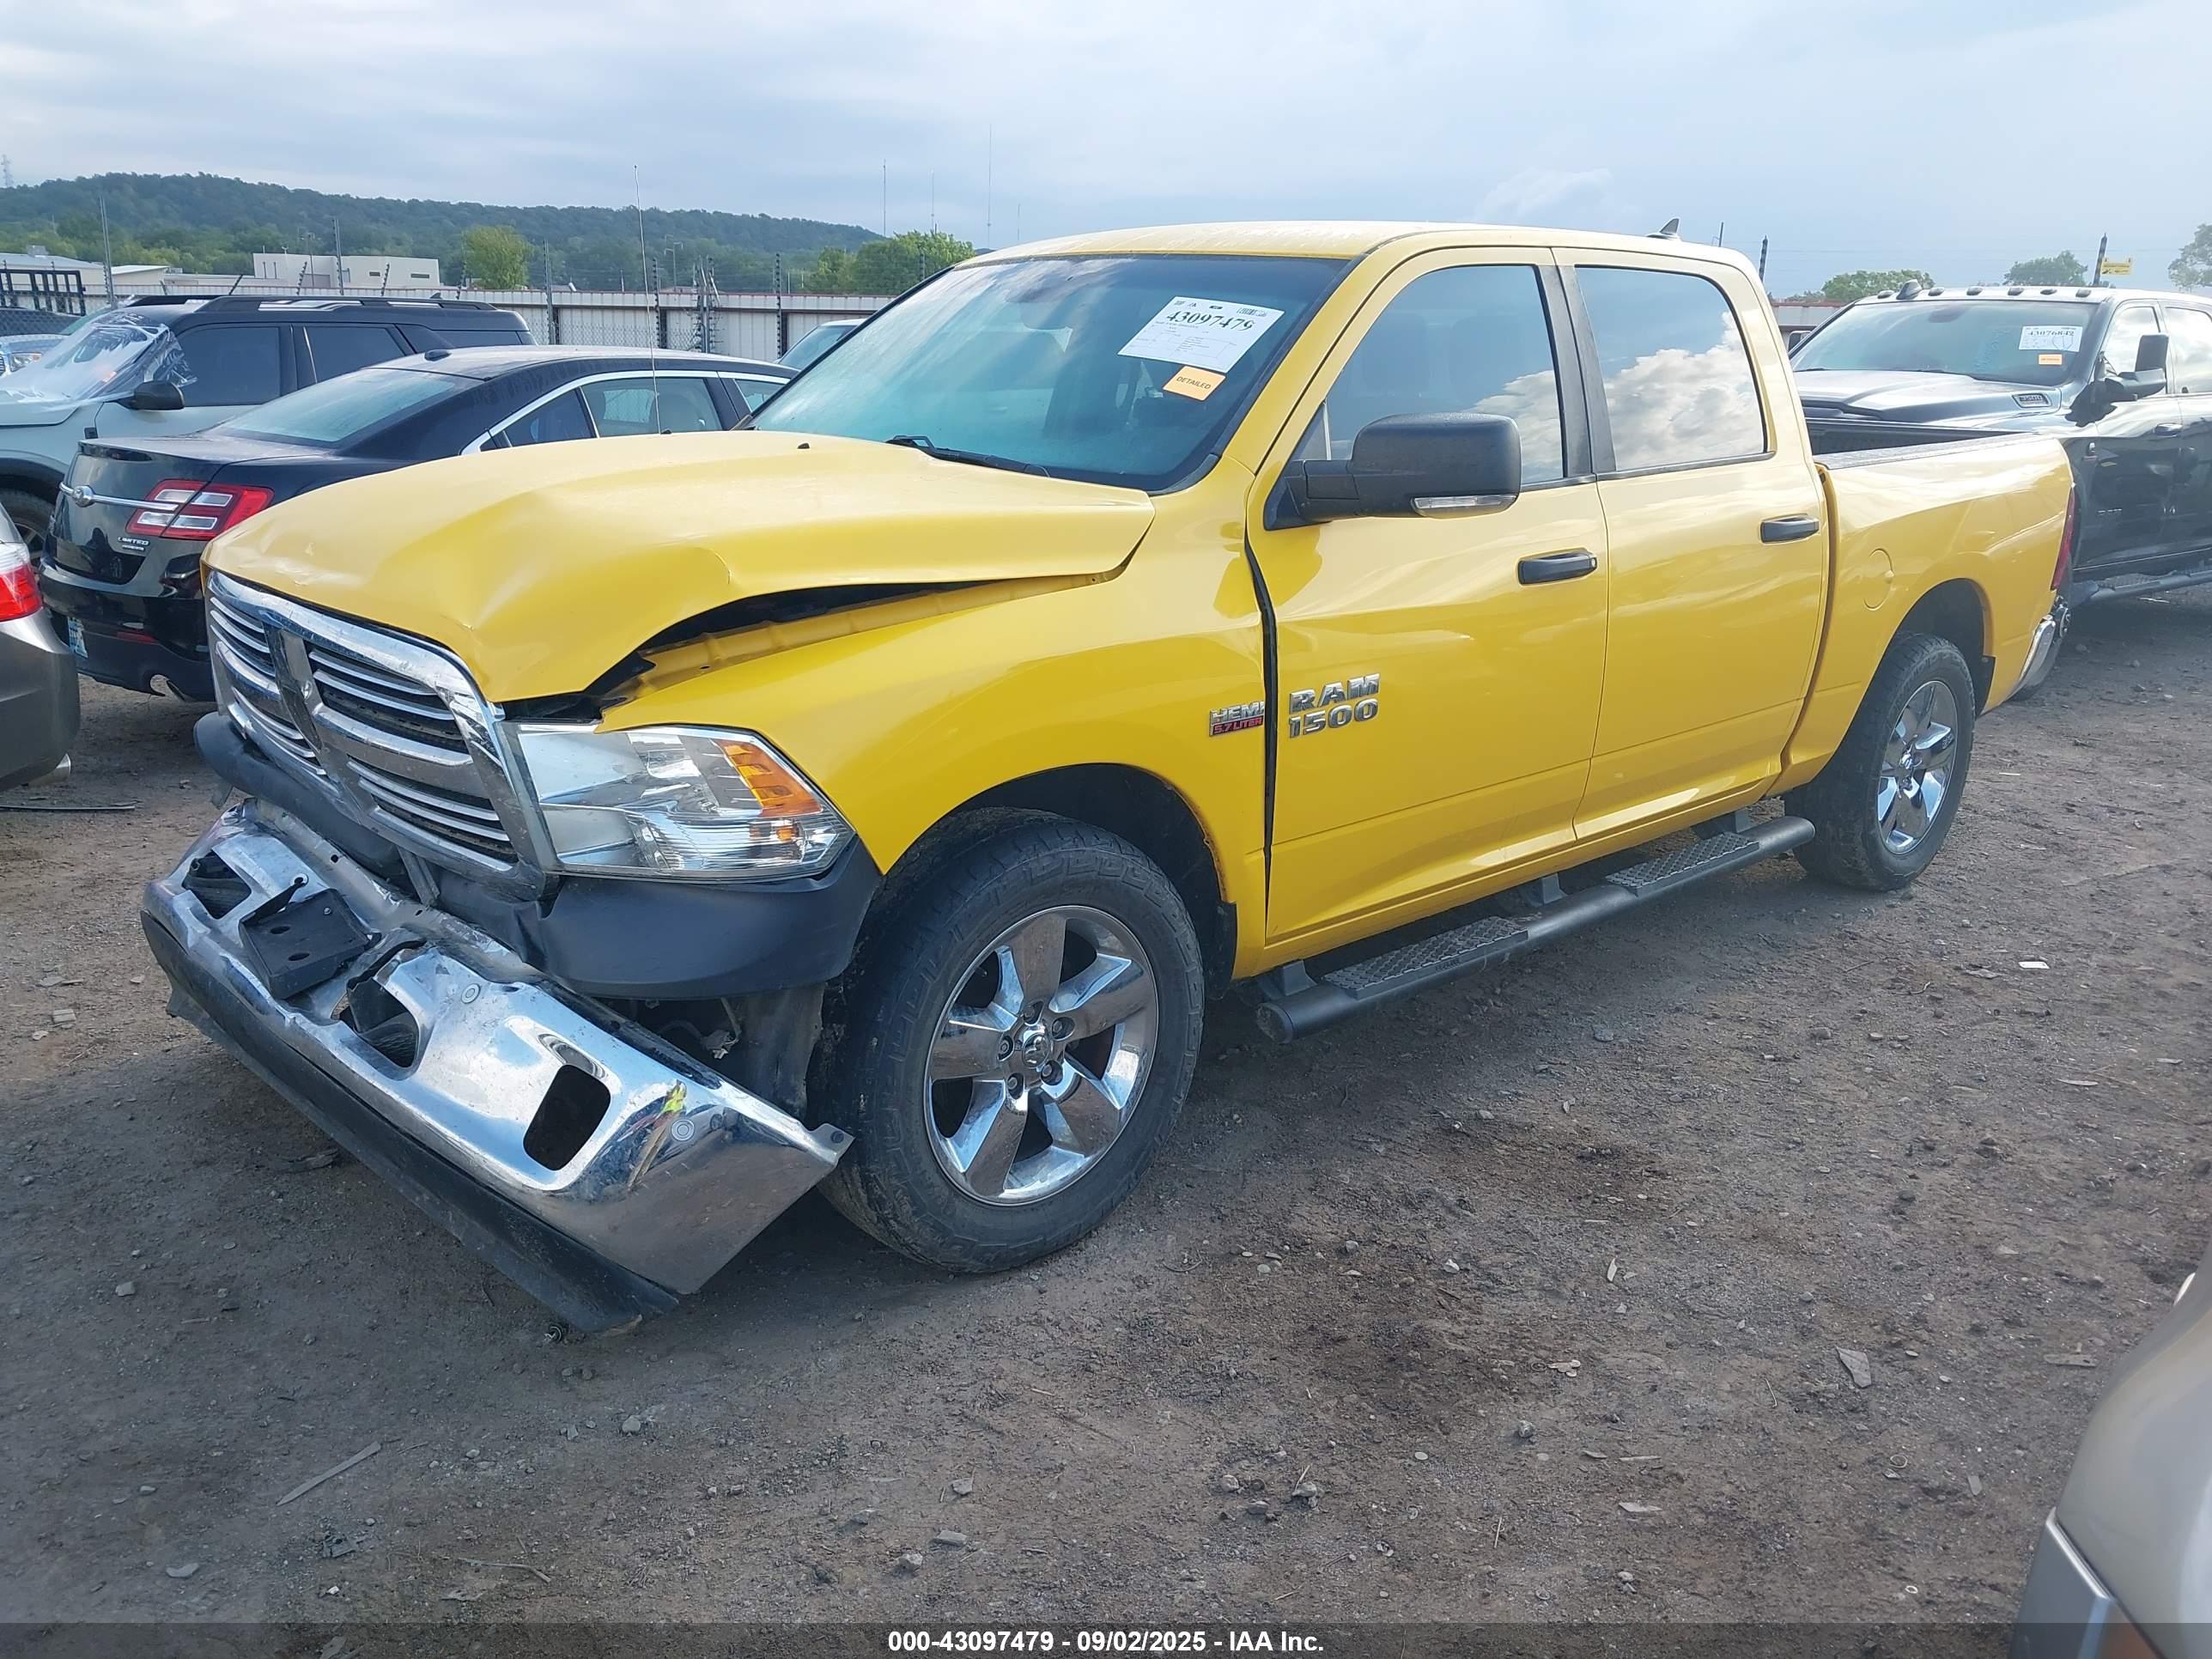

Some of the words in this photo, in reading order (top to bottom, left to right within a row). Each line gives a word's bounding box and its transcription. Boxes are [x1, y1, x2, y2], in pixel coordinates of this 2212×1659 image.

[1176, 375, 1212, 390] DETAILED
[1289, 673, 1380, 713] RAM
[1289, 697, 1379, 738] 1500
